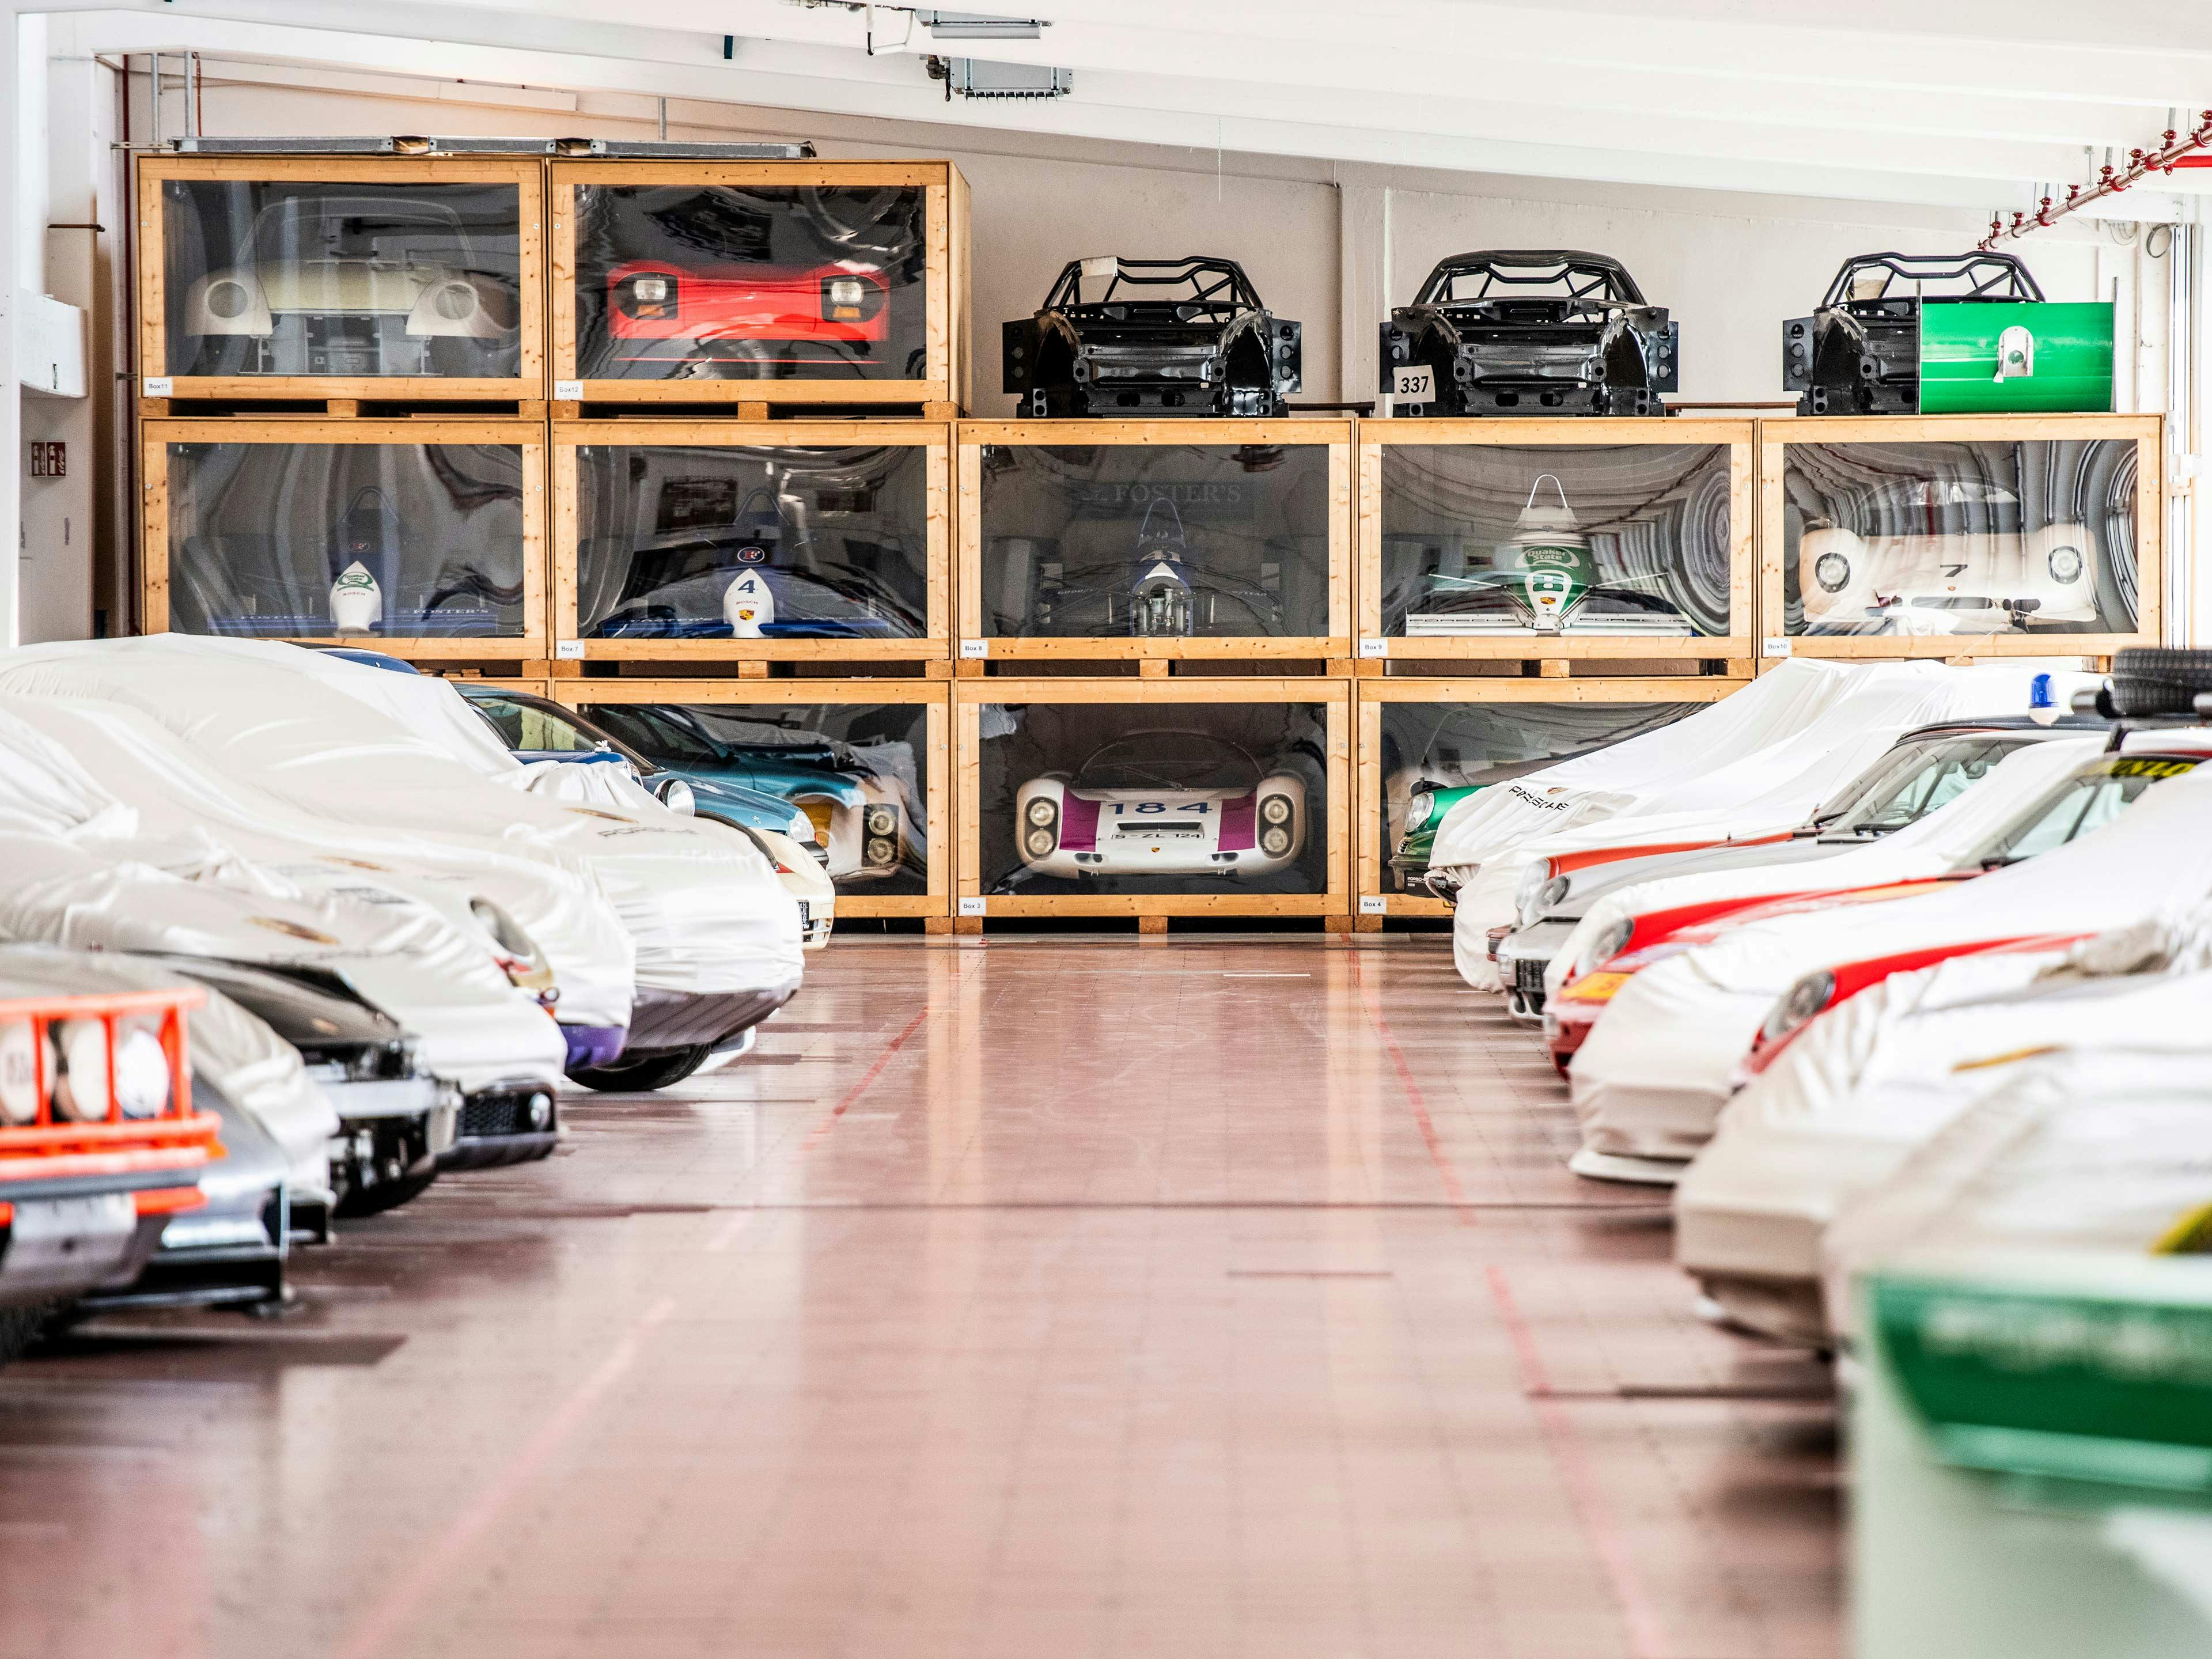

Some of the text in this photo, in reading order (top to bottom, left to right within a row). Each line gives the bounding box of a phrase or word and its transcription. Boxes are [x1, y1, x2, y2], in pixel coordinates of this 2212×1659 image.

[1400, 376, 1429, 394] 337
[1527, 549, 1567, 557] Quaker
[1940, 564, 1968, 577] 7
[737, 579, 756, 594] 4
[1532, 573, 1564, 592] 8
